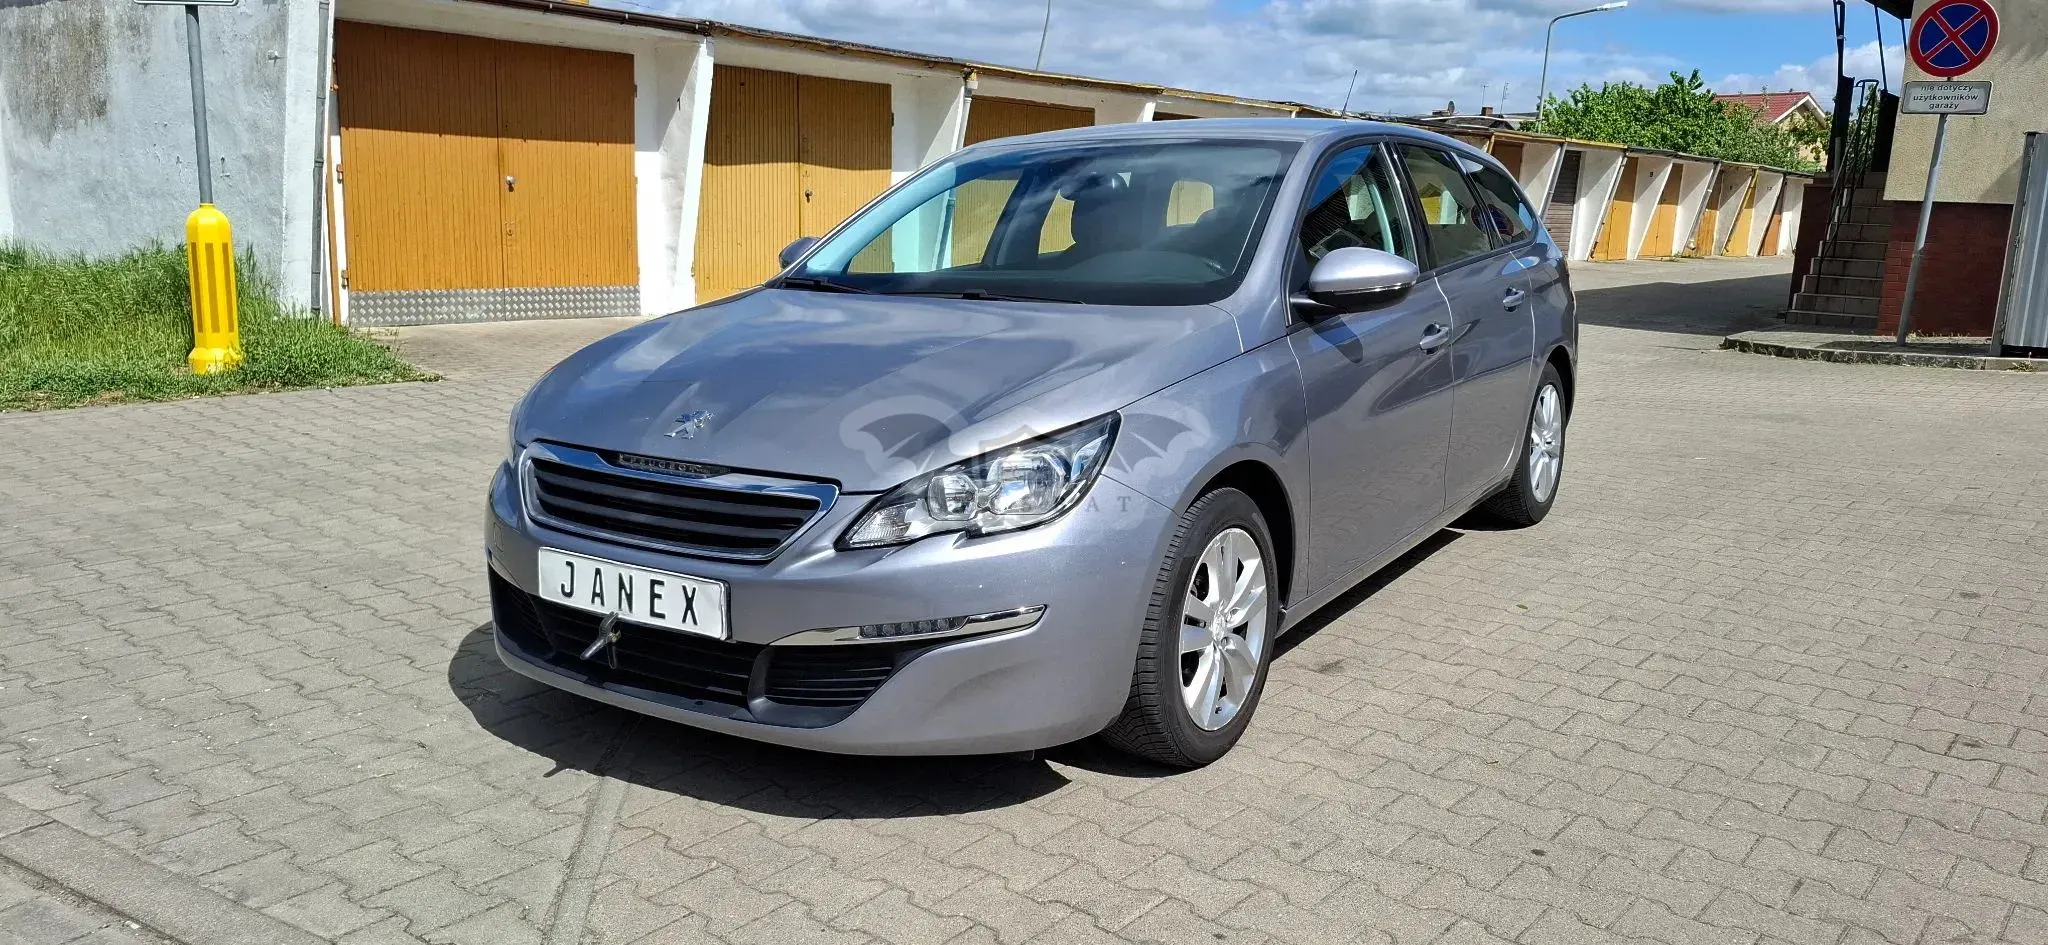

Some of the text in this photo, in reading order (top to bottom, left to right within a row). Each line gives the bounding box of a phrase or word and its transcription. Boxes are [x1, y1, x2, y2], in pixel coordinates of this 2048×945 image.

[1937, 84, 1974, 92] dotyczy
[1913, 93, 1979, 102] użytkowników
[1929, 101, 1960, 110] garaży
[560, 561, 698, 626] JANEX
